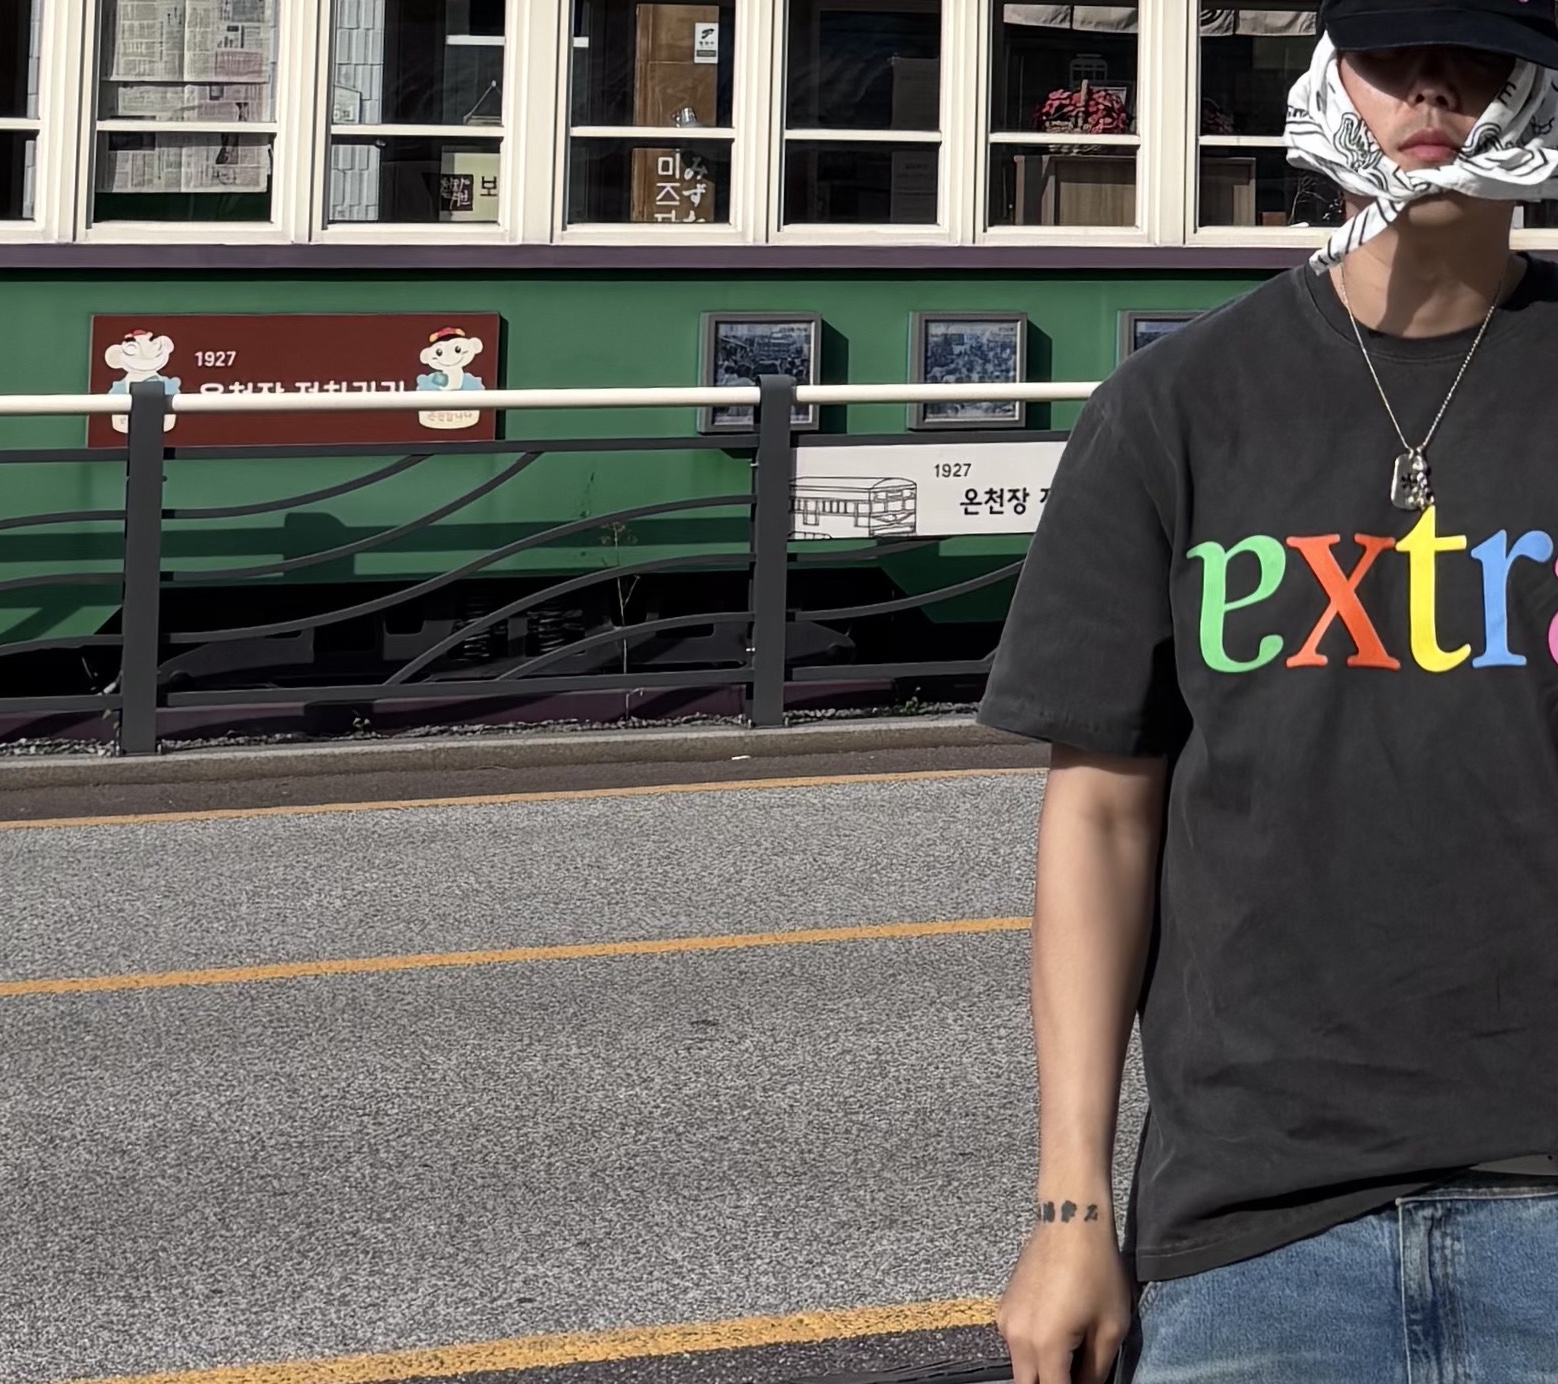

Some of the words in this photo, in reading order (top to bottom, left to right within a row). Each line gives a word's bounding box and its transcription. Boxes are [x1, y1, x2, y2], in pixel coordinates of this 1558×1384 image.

[194, 350, 236, 367] 1927
[934, 463, 972, 478] 1927
[959, 487, 1030, 515] 온천장
